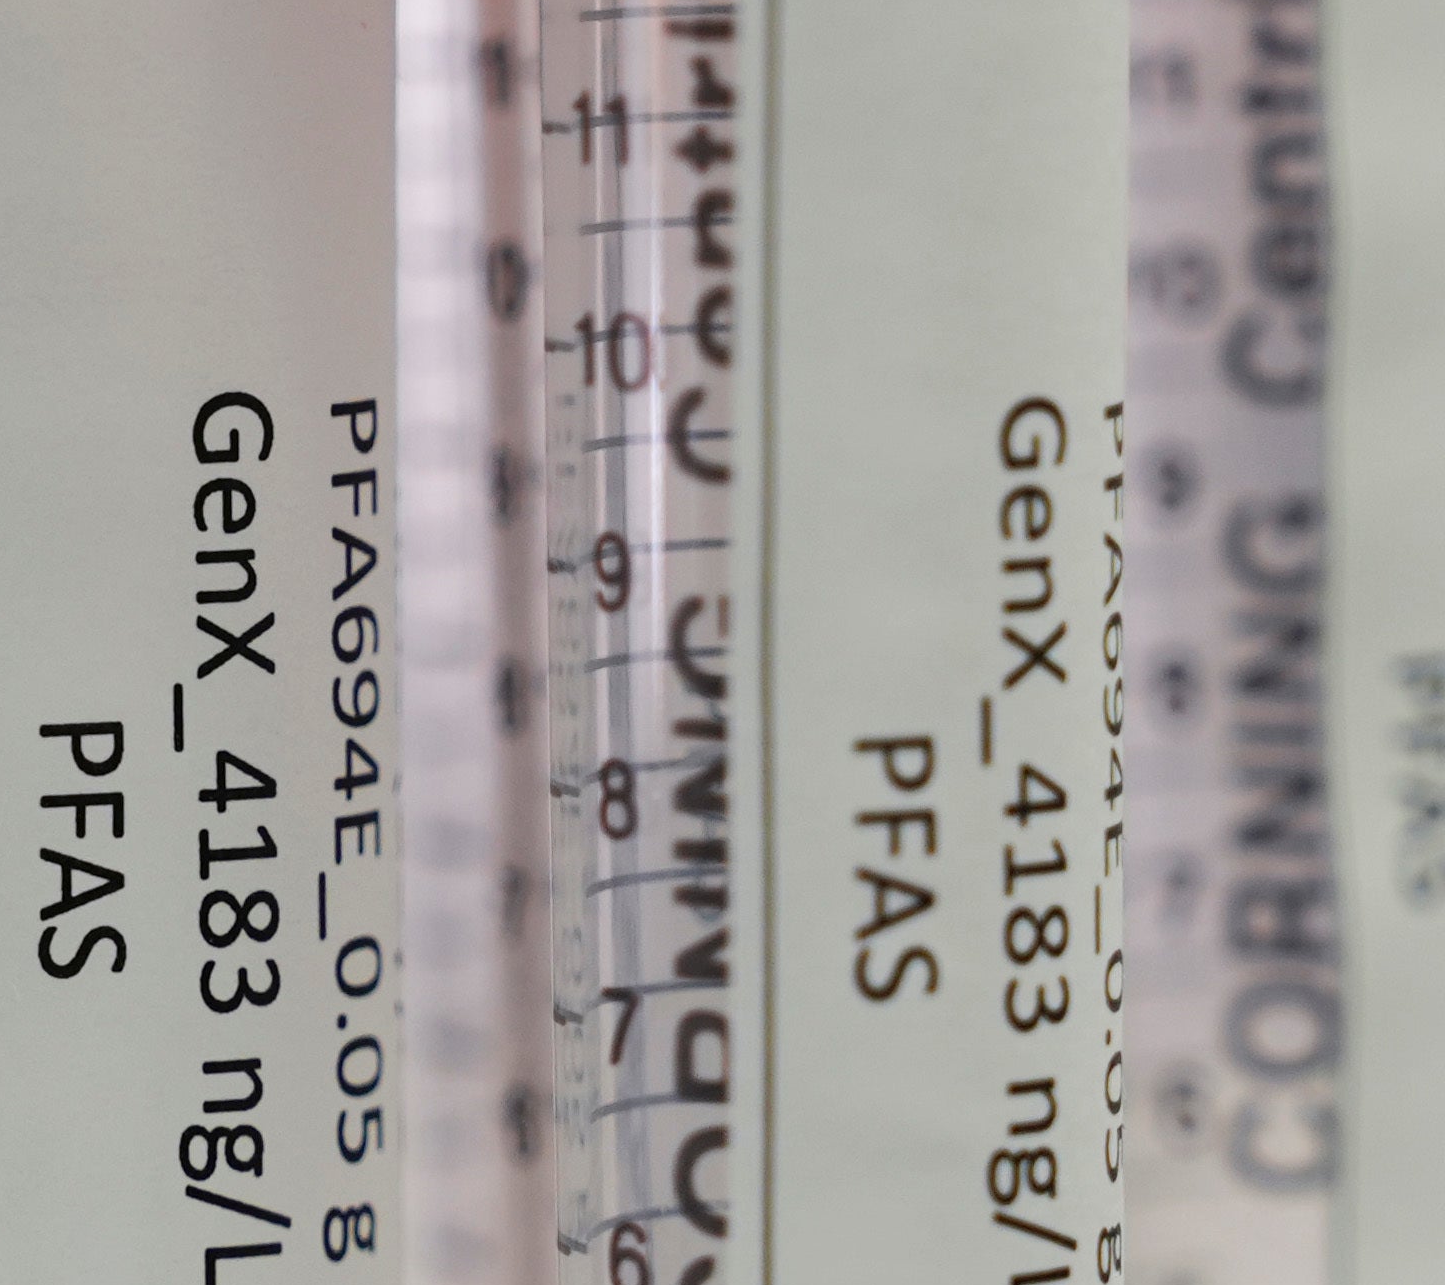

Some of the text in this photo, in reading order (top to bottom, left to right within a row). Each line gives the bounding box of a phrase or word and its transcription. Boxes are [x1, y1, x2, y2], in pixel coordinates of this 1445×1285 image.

[574, 91, 632, 167] 11
[574, 312, 654, 393] 10
[593, 531, 630, 613] 9
[173, 390, 281, 1016] GenX_4183
[981, 395, 1069, 1032] GenX_4183
[40, 721, 126, 979] PFAS
[318, 398, 384, 1262] PFA694E_0.05 g
[597, 757, 638, 840] 8
[851, 733, 939, 1002] PFAS
[600, 985, 637, 1068] 7
